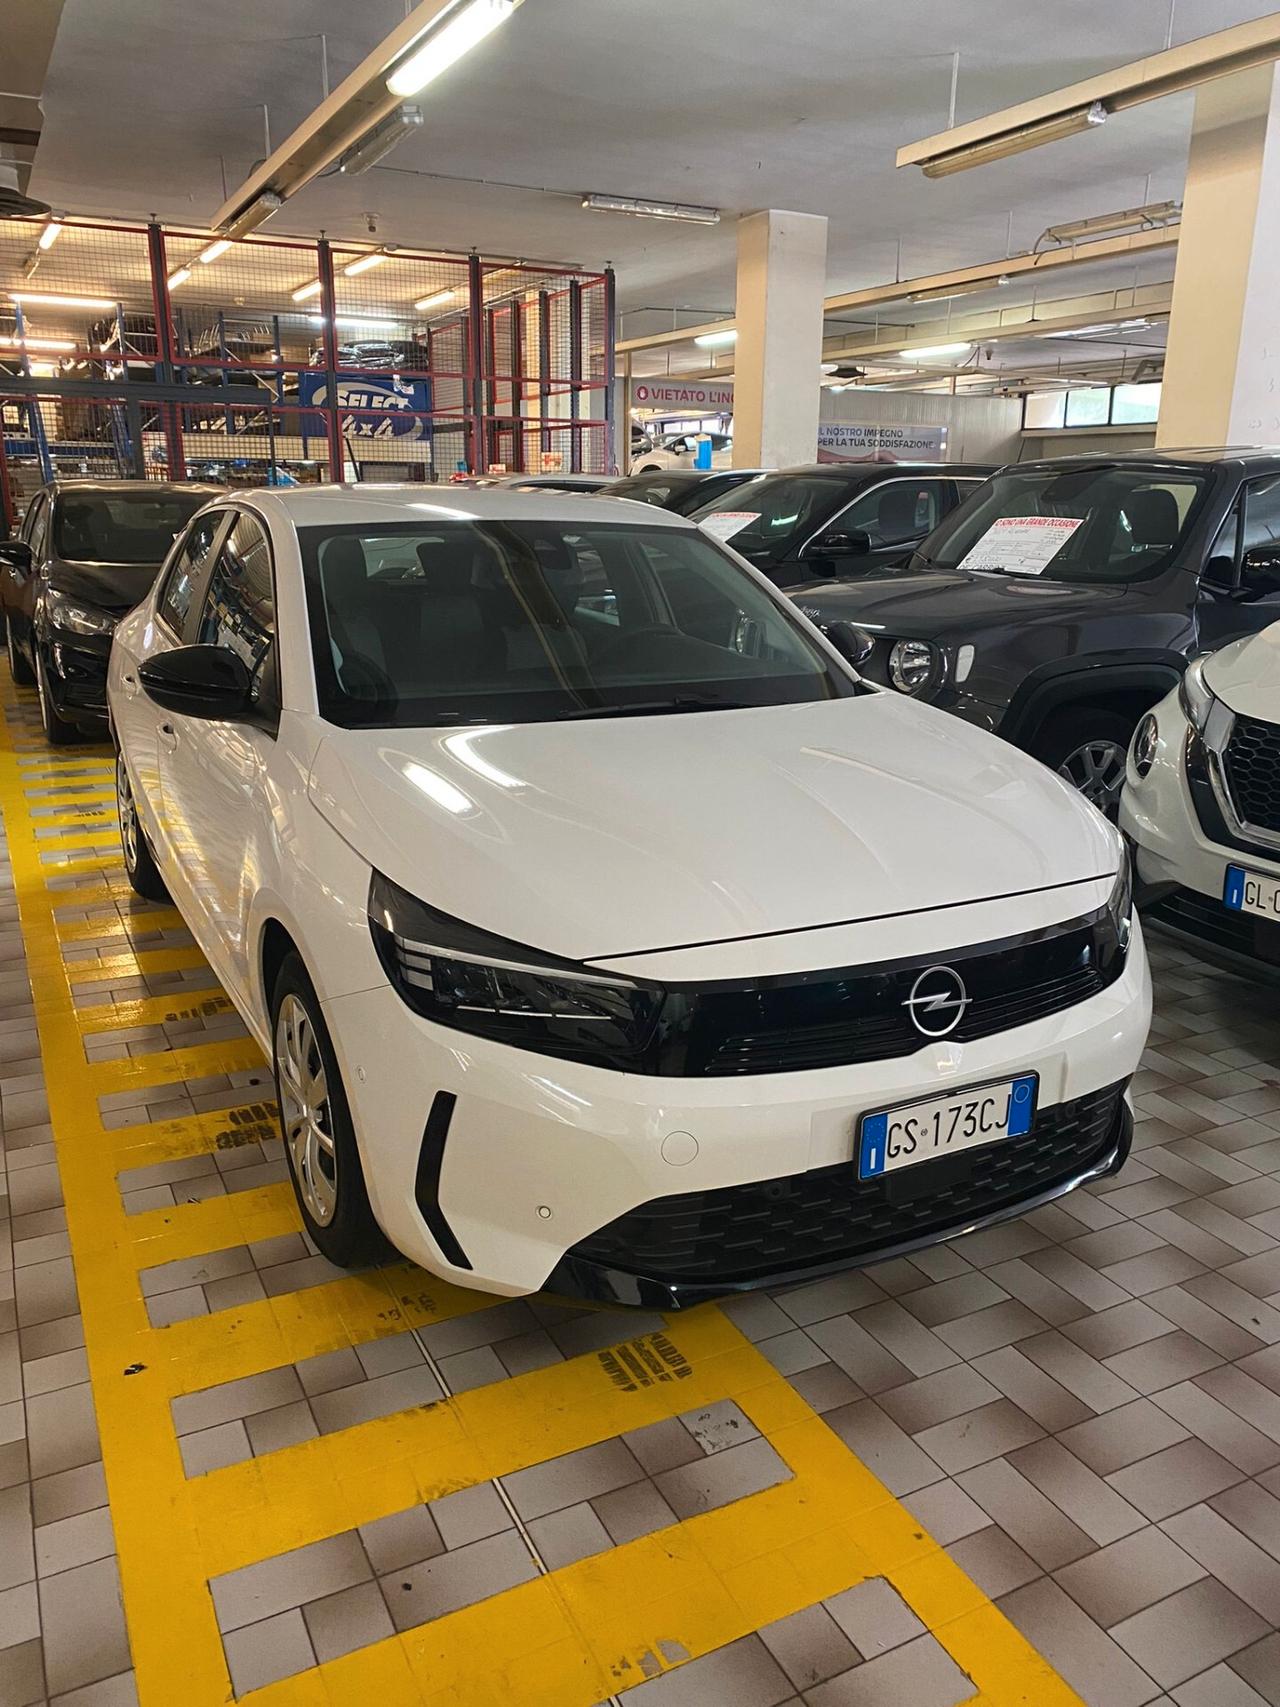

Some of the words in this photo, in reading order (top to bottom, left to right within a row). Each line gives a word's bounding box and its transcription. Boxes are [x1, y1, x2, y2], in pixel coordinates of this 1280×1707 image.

[337, 389, 413, 410] SELECT
[651, 388, 706, 402] VIETATO
[709, 391, 734, 404] L'IN
[826, 427, 861, 437] NOSTRO
[863, 428, 903, 438] IMPEGNO
[817, 438, 834, 447] PER
[835, 438, 847, 447] LA
[849, 438, 866, 448] TUA
[1245, 881, 1266, 910] GL
[887, 1118, 919, 1159] GS
[932, 1093, 1012, 1147] 173CJ
